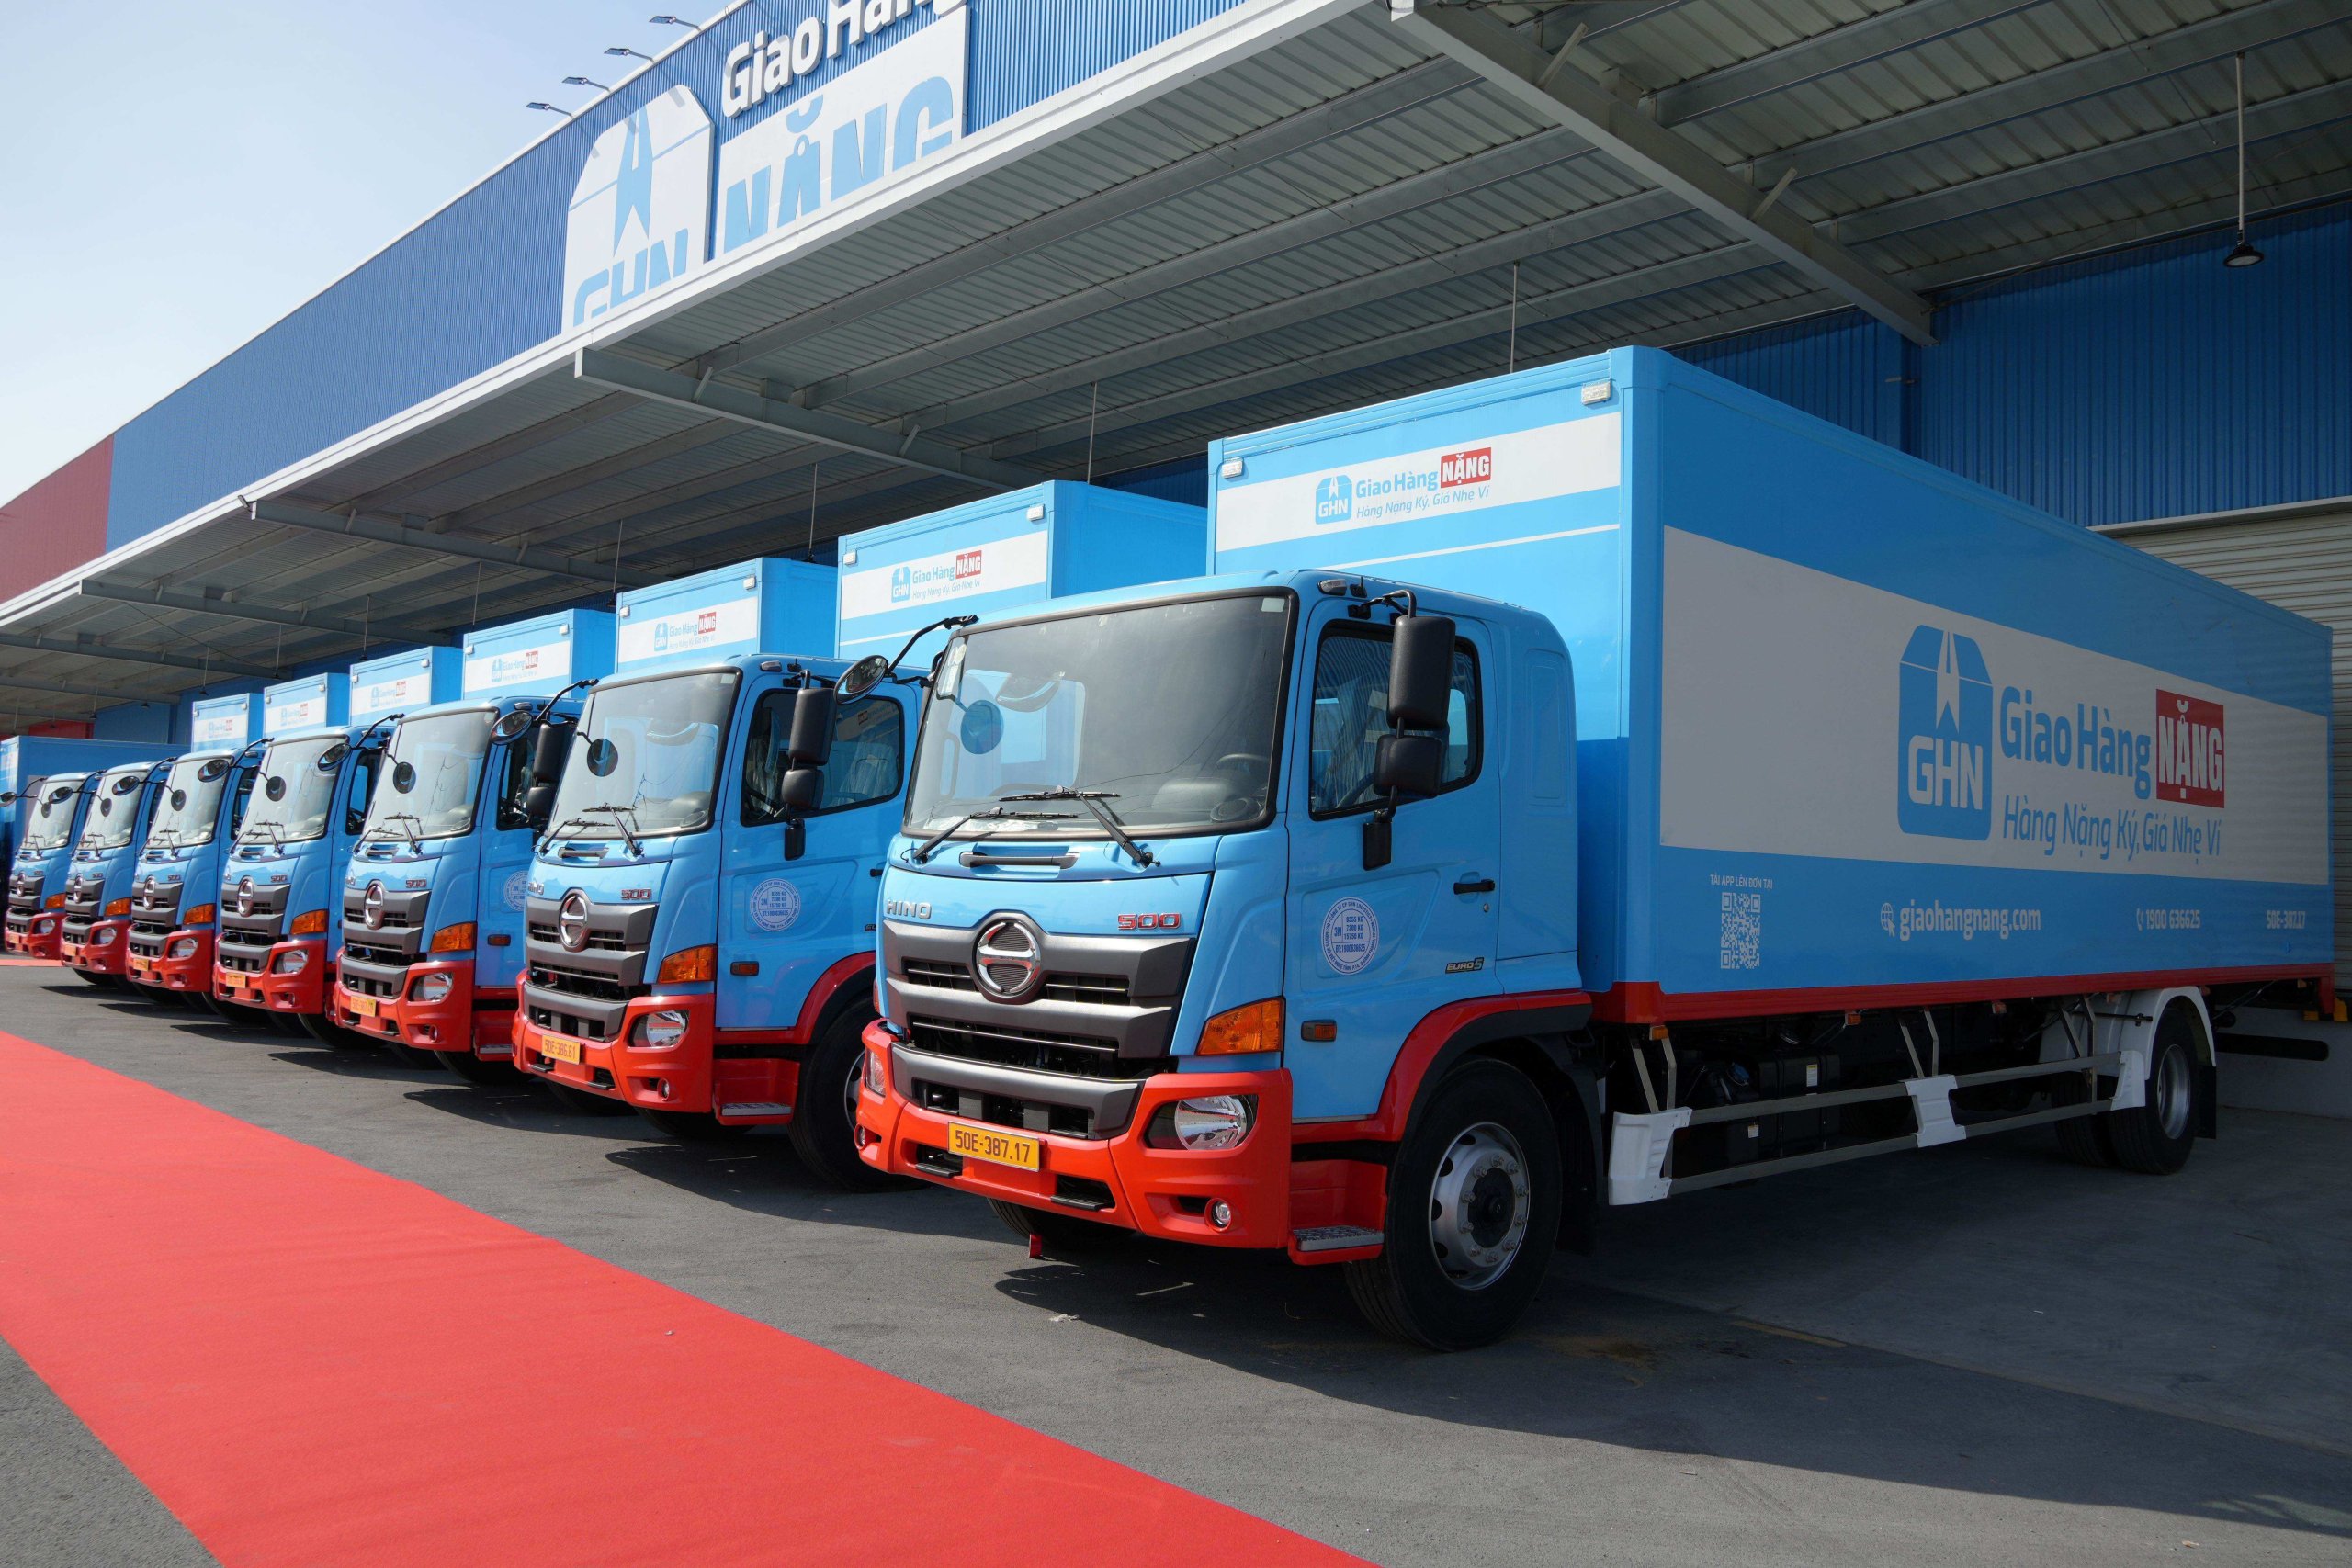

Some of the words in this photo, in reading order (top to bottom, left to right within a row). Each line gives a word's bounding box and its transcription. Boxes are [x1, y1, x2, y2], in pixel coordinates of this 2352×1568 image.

[722, 16, 824, 118] Giao
[1355, 479, 1392, 499] Giao
[1394, 469, 1439, 491] Hàng
[1442, 453, 1489, 484] NẶNG
[1318, 498, 1348, 518] GHN
[1385, 501, 1413, 515] Nặng
[1453, 489, 1475, 502] Nhẹ
[912, 570, 932, 584] Giao
[2000, 686, 2072, 767] Giao
[2077, 703, 2151, 800] Hàng
[2158, 699, 2222, 799] NẶNG
[1909, 735, 1983, 809] GHN
[2003, 794, 2057, 856] Hàng
[2063, 801, 2112, 861] Nặng
[2143, 812, 2168, 853] Giá
[2172, 815, 2202, 865] Nhẹ
[1722, 875, 1735, 886] APP
[621, 888, 652, 900] 500
[886, 899, 932, 919] HINO
[1900, 899, 2041, 941] giaohangnang.com
[2145, 908, 2166, 930] 1900
[1117, 912, 1181, 931] 500
[1334, 926, 1342, 937] 3N
[956, 1129, 1031, 1163] 50E-387.17
